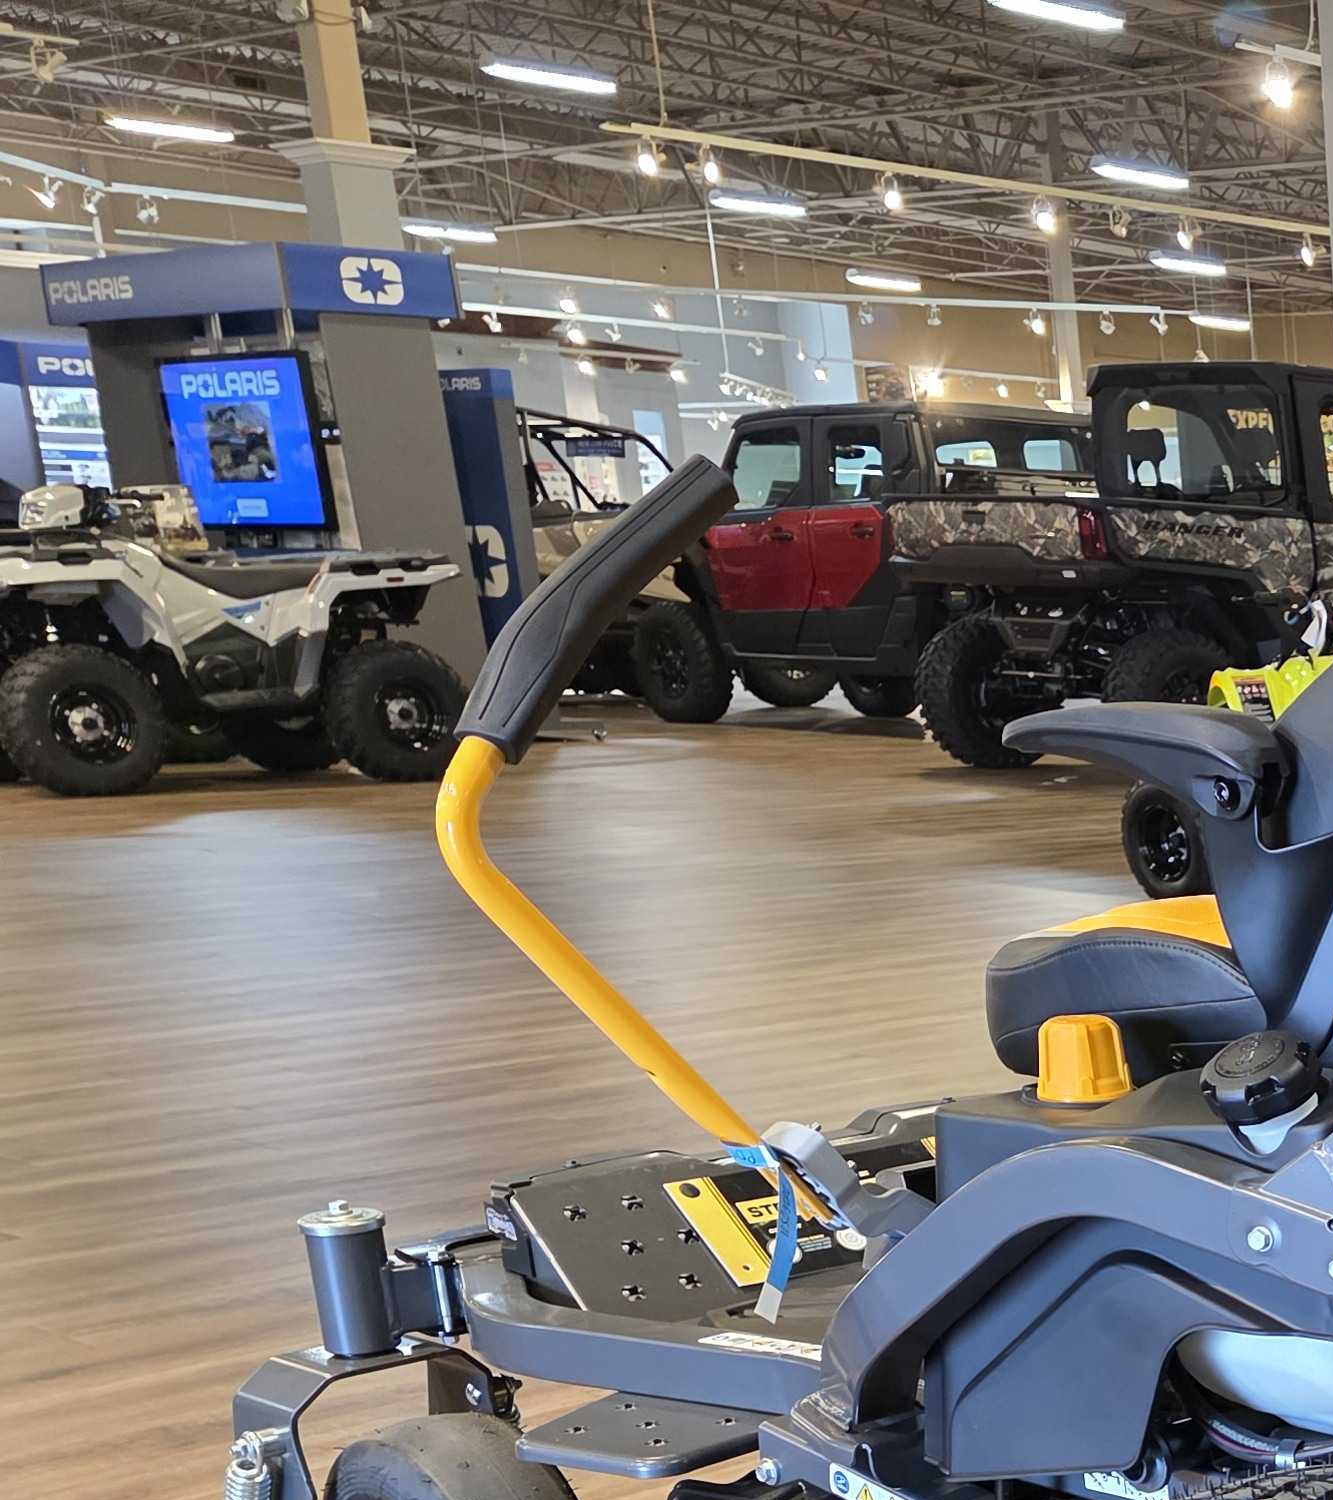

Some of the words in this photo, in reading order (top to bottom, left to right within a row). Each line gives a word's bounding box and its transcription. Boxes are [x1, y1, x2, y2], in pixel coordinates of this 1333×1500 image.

[48, 275, 134, 305] POLARIS
[180, 369, 281, 399] POLARIS
[1143, 520, 1244, 538] RANGER
